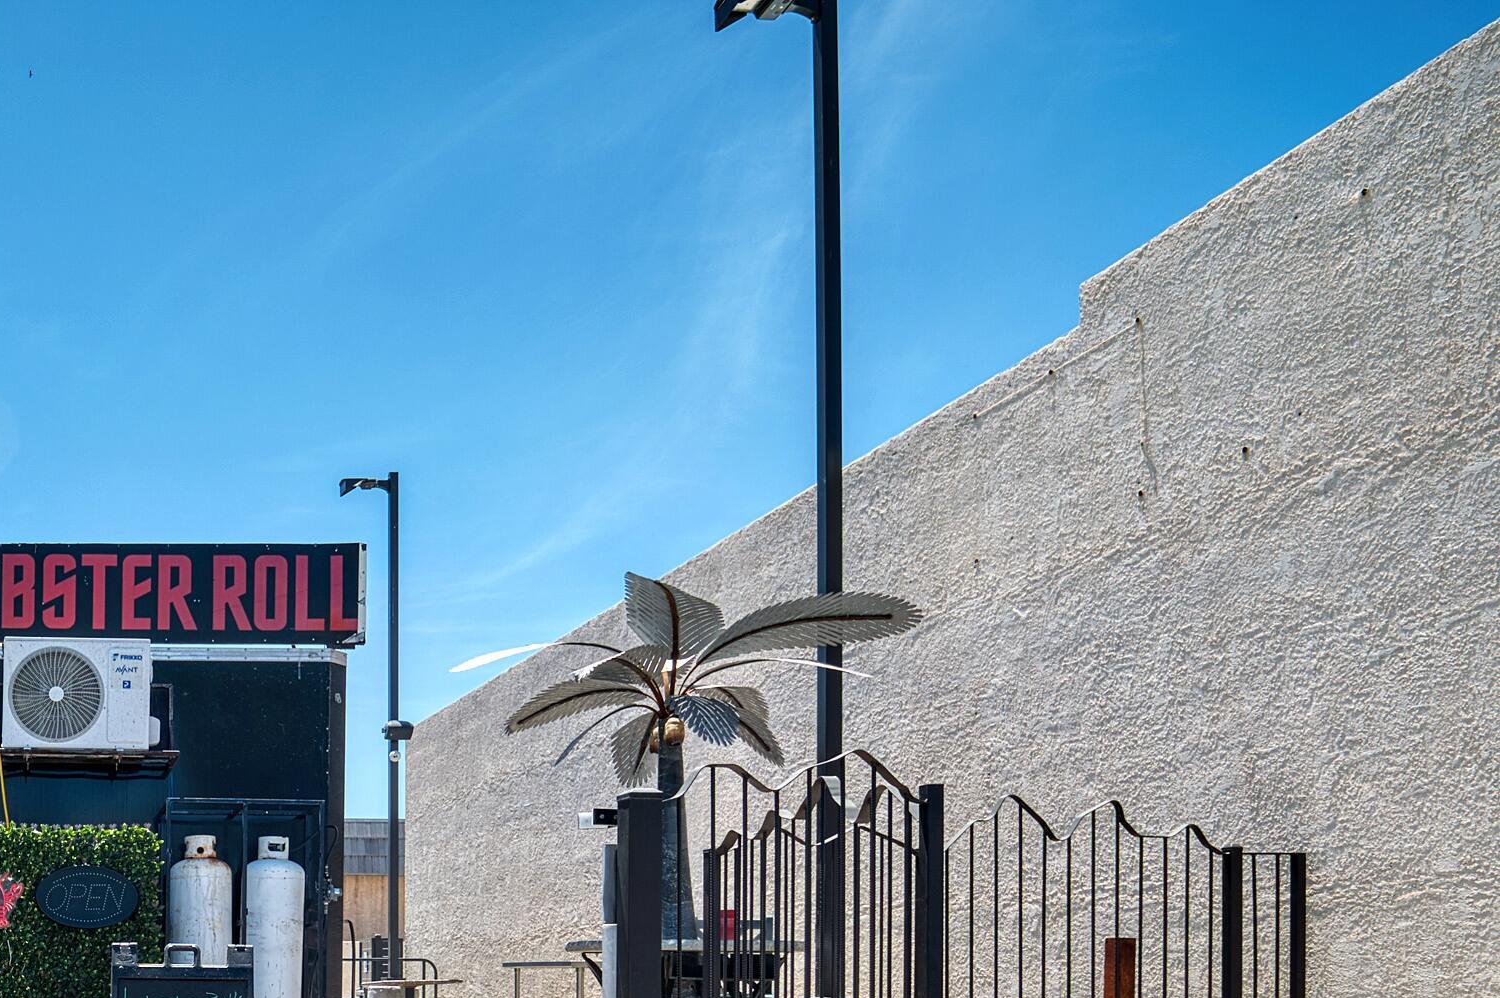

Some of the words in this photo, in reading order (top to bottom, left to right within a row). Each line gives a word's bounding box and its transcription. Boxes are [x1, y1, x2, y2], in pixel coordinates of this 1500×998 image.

[212, 554, 358, 631] ROLL
[115, 664, 138, 675] AVANT
[45, 883, 127, 912] OPEN
